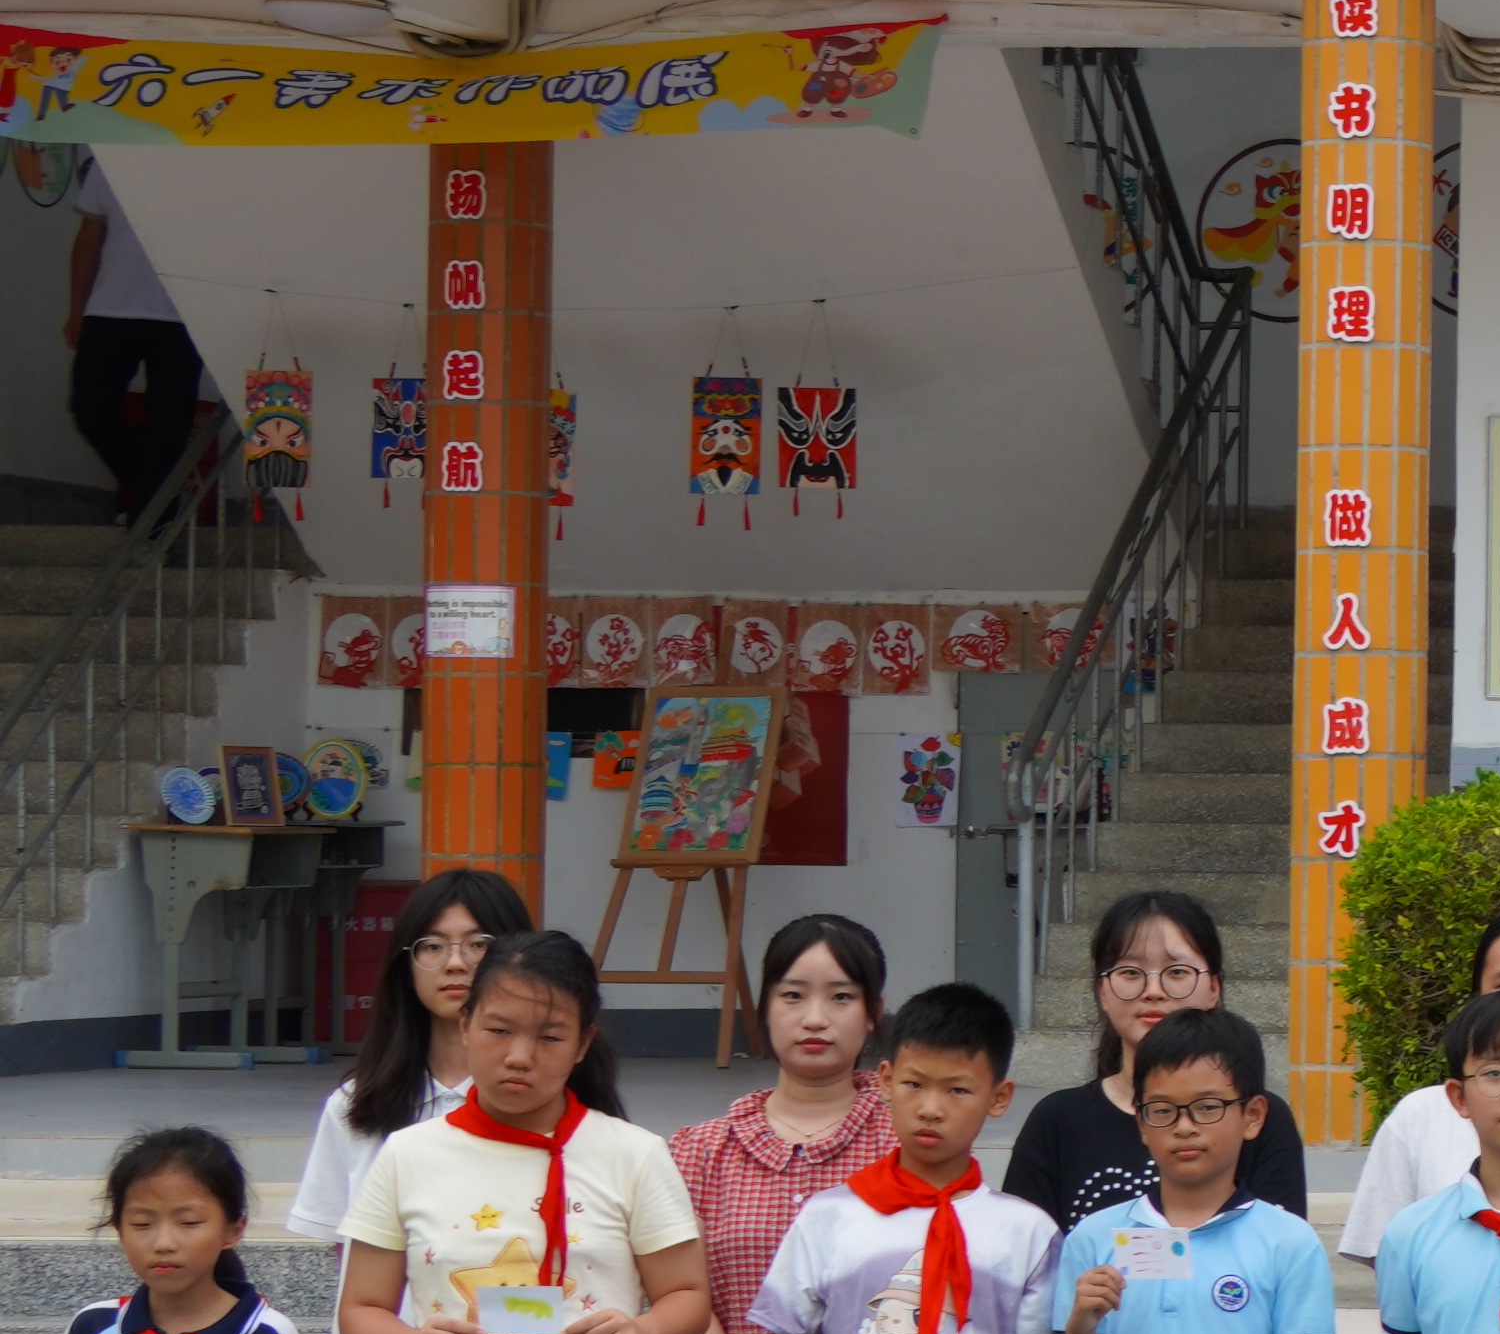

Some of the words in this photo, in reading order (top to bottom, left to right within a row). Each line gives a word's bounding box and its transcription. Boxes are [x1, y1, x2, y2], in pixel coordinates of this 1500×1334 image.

[93, 50, 732, 111] 六一美术作品展
[442, 169, 487, 493] 扬帆起航
[1318, 488, 1371, 861] 做人成才
